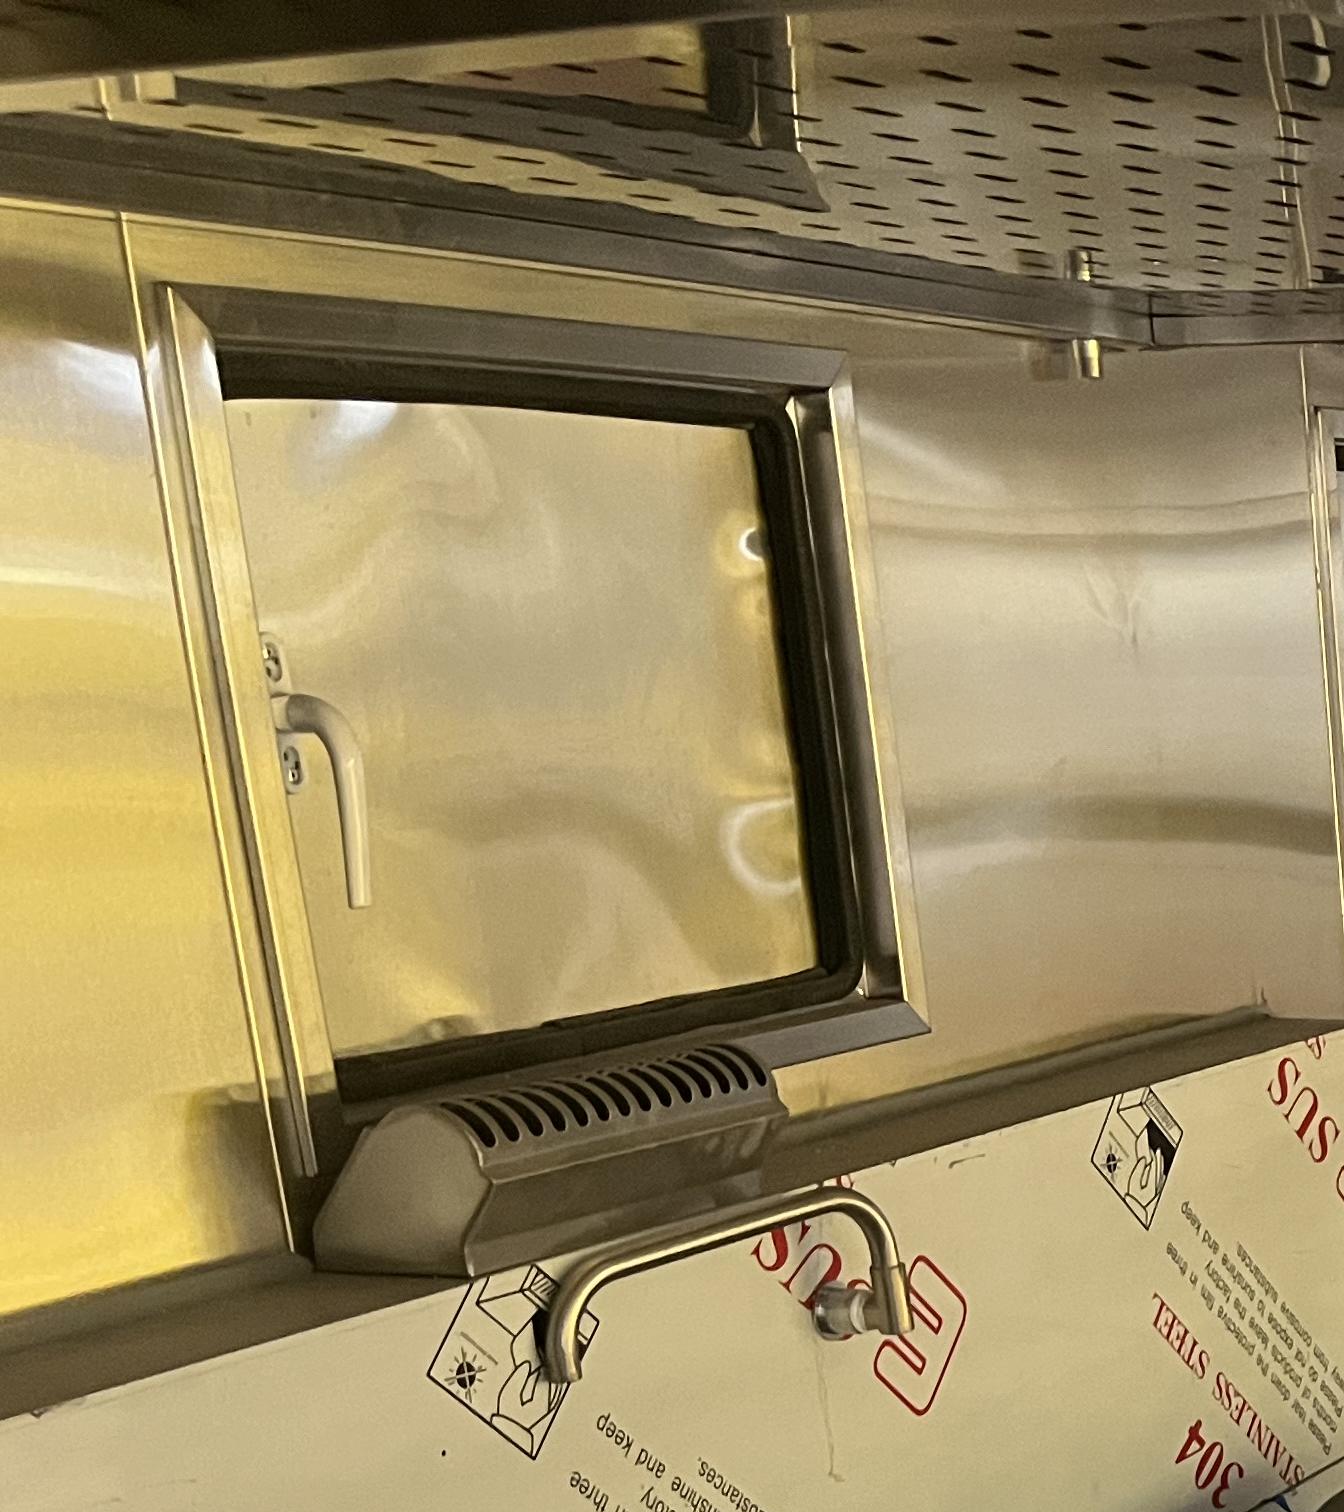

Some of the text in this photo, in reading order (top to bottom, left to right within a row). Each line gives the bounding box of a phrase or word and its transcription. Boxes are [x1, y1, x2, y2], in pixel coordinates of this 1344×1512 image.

[1267, 1057, 1340, 1163] SUS
[1152, 1291, 1305, 1488] STAINLESS STEEL
[596, 1412, 634, 1458] keep
[634, 1448, 666, 1479] and
[1175, 1419, 1244, 1509] 304
